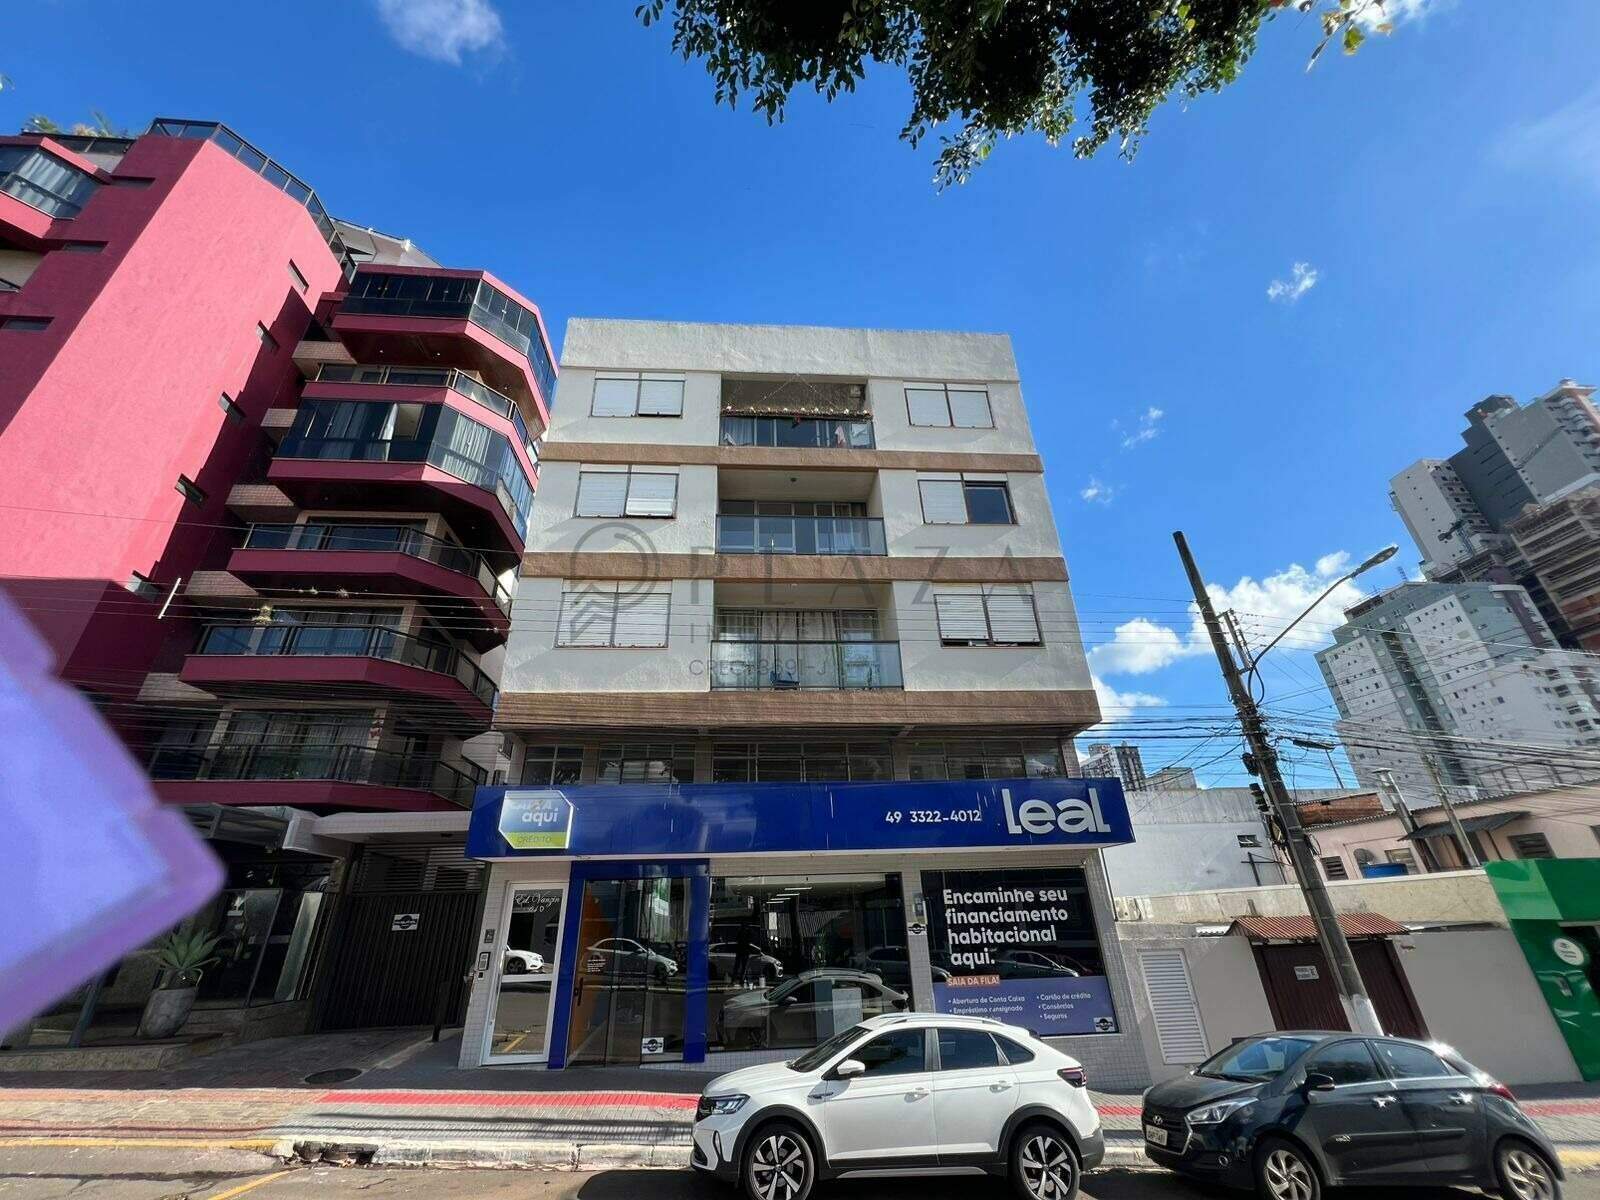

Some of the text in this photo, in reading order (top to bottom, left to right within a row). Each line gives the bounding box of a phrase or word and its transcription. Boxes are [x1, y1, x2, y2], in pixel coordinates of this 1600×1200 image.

[521, 807, 559, 827] aqui
[885, 809, 982, 824] 49 3322-4012
[1001, 787, 1112, 835] leal
[943, 886, 1068, 905] Encaminhe seu
[945, 906, 1068, 925] financiamento
[947, 924, 1057, 945] habitacional
[950, 947, 996, 970] aqui.
[948, 976, 966, 987] SAIA
[967, 976, 979, 986] DA
[952, 996, 979, 1005] Abertura
[988, 995, 1007, 1004] Conta
[1043, 1013, 1068, 1021] Seguros
